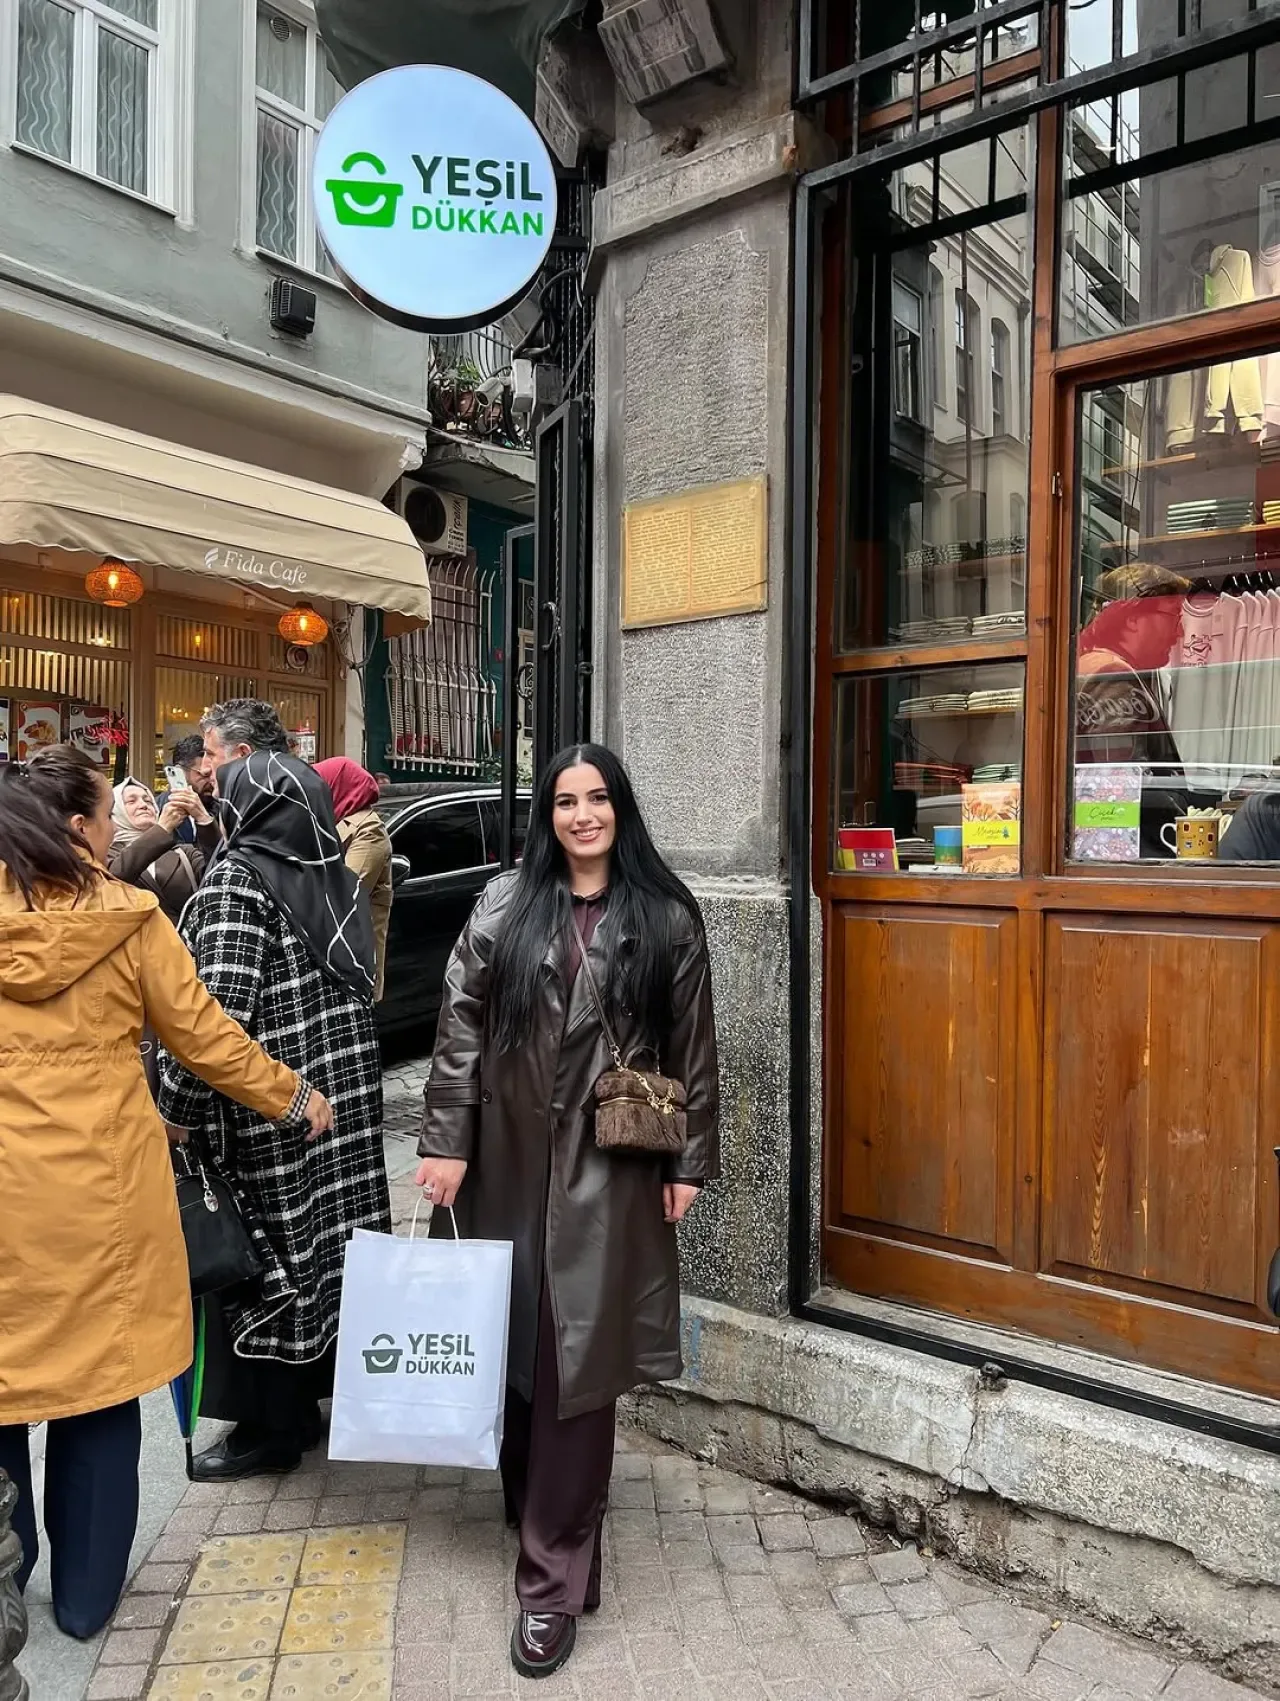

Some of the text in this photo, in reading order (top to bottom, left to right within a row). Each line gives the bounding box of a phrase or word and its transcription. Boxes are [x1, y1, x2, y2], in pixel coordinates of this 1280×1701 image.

[411, 200, 544, 236] DÜKKAN
[222, 550, 264, 574] Fida
[405, 1356, 475, 1376] DÜKKAN
